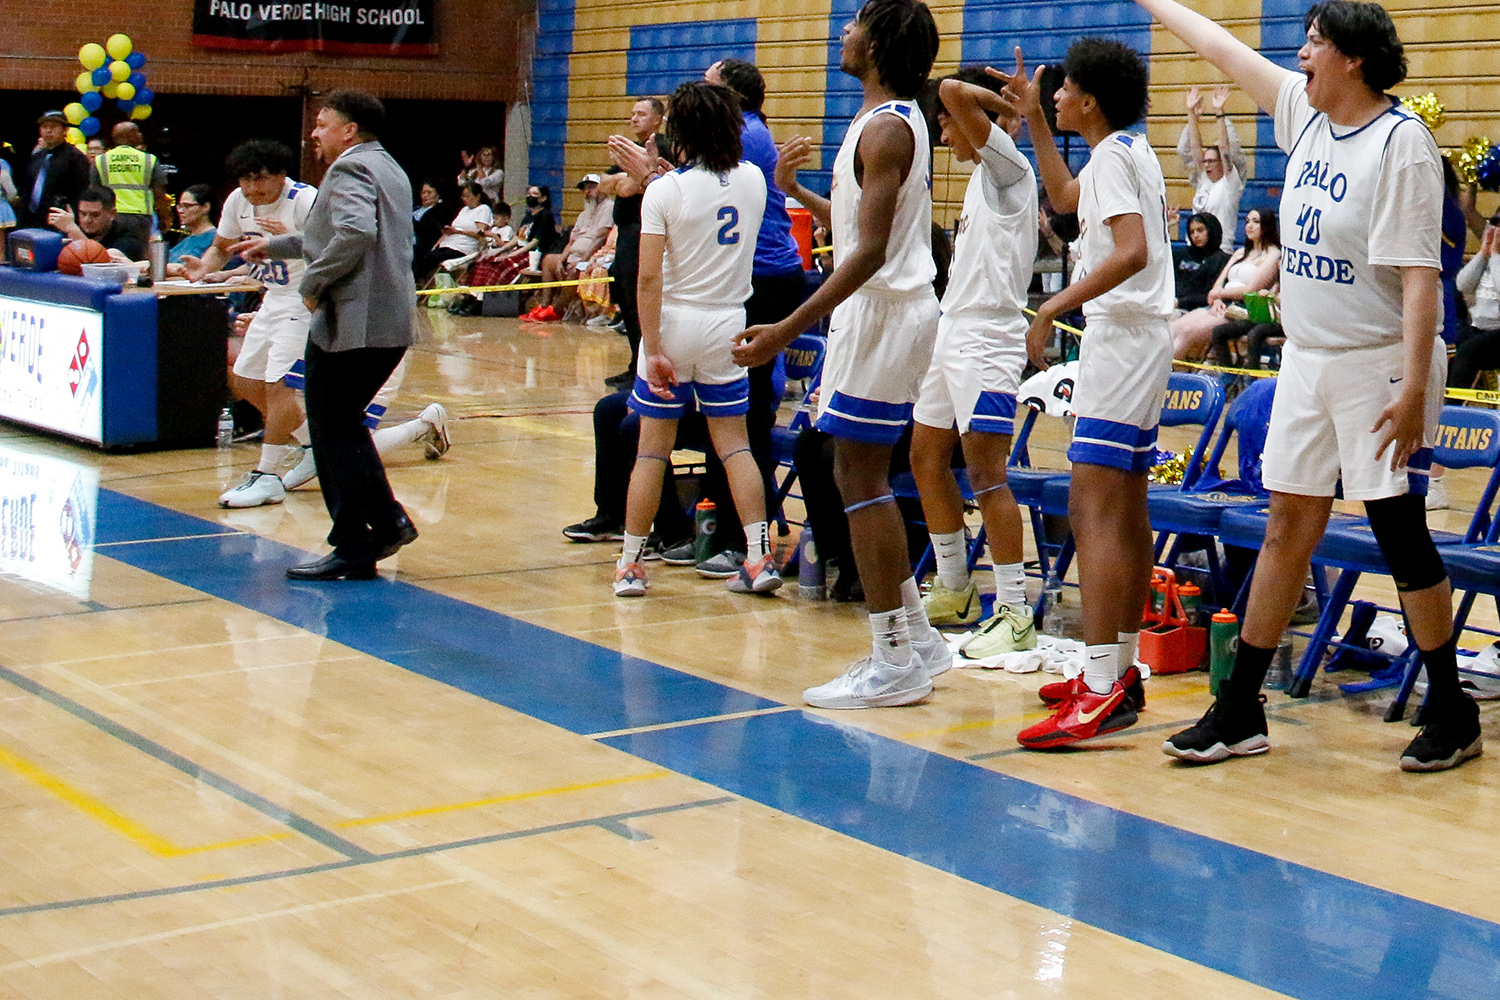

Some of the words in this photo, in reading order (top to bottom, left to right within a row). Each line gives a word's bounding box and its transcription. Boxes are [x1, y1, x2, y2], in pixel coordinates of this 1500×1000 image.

[258, 3, 312, 21] VERDE
[315, 2, 350, 23] HIGH
[356, 8, 425, 25] SCHOOL
[108, 164, 142, 173] SECURITY
[1293, 160, 1347, 202] PALO
[717, 205, 739, 245] 2
[1296, 203, 1322, 245] 40
[1161, 390, 1203, 410] TANS
[1434, 424, 1493, 450] ITANS
